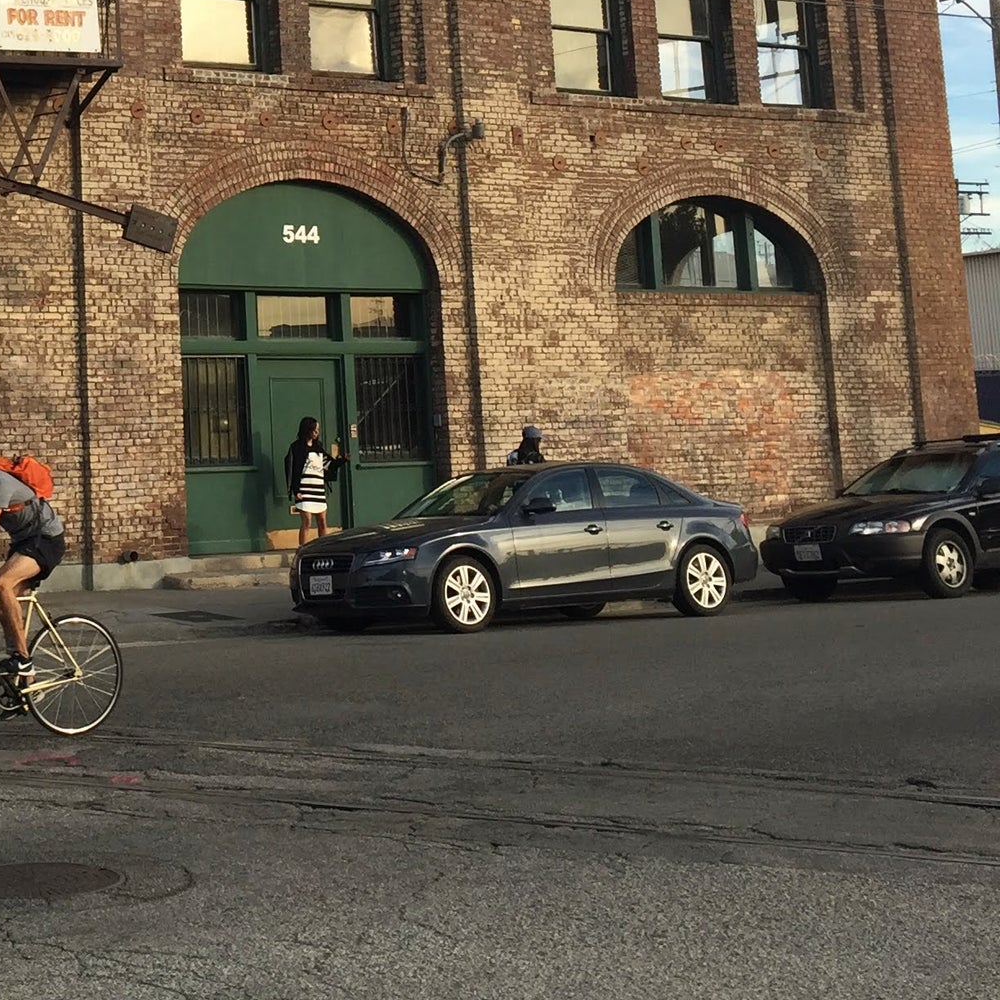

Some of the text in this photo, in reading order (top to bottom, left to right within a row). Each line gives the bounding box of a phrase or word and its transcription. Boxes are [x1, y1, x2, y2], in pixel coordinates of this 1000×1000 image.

[6, 7, 87, 28] FOR RENT
[282, 224, 321, 244] 544
